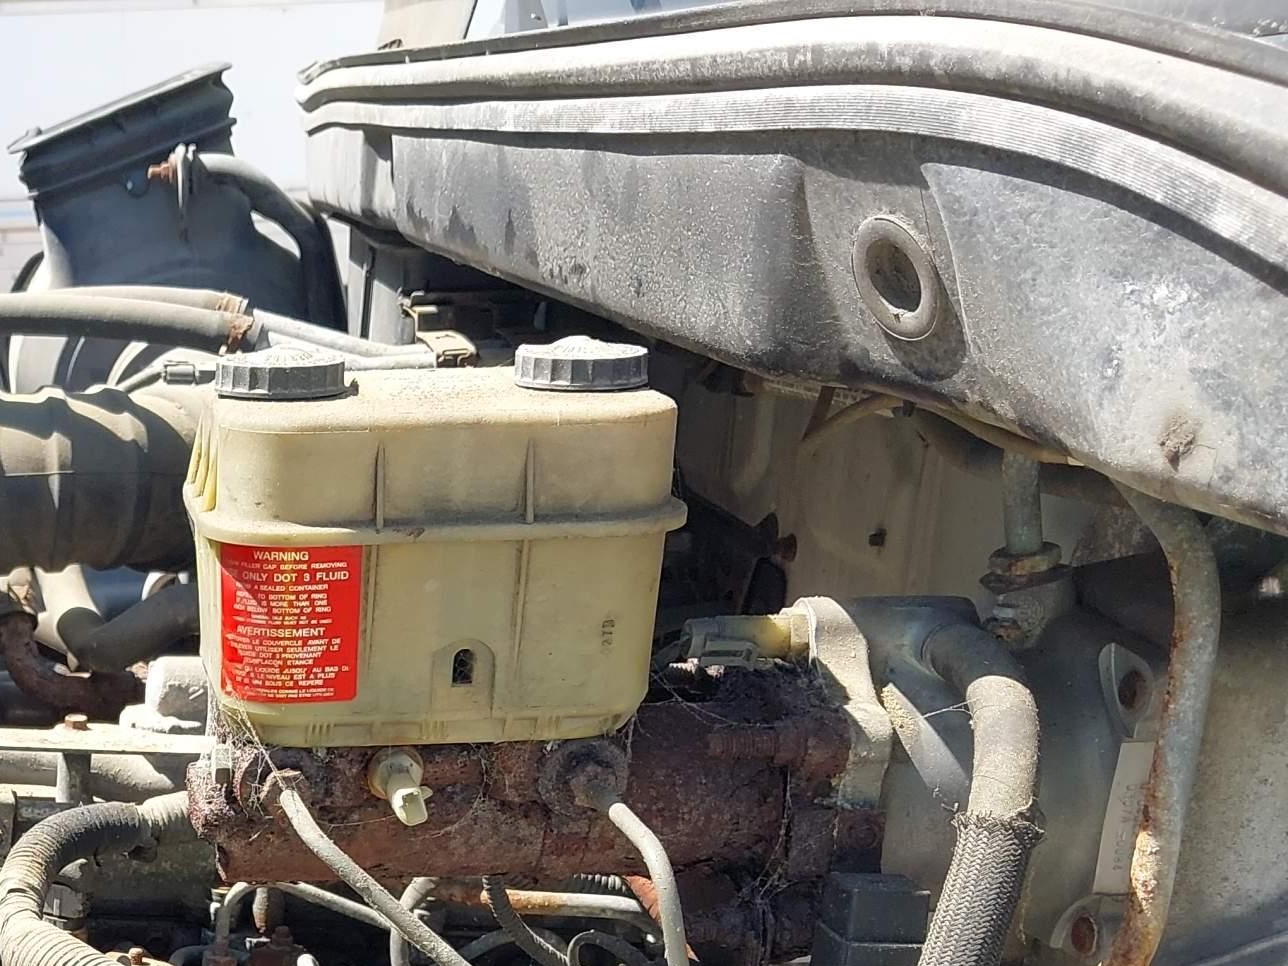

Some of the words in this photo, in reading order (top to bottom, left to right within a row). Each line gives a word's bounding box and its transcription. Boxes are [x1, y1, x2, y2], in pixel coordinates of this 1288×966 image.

[253, 551, 309, 561] WARNING
[242, 571, 269, 582] ONLY
[273, 573, 298, 582] DOT
[303, 573, 311, 582] 3
[316, 571, 349, 581] FLUID
[237, 625, 326, 637] AVERTISSEMENT
[286, 645, 328, 653] SEULEMENT
